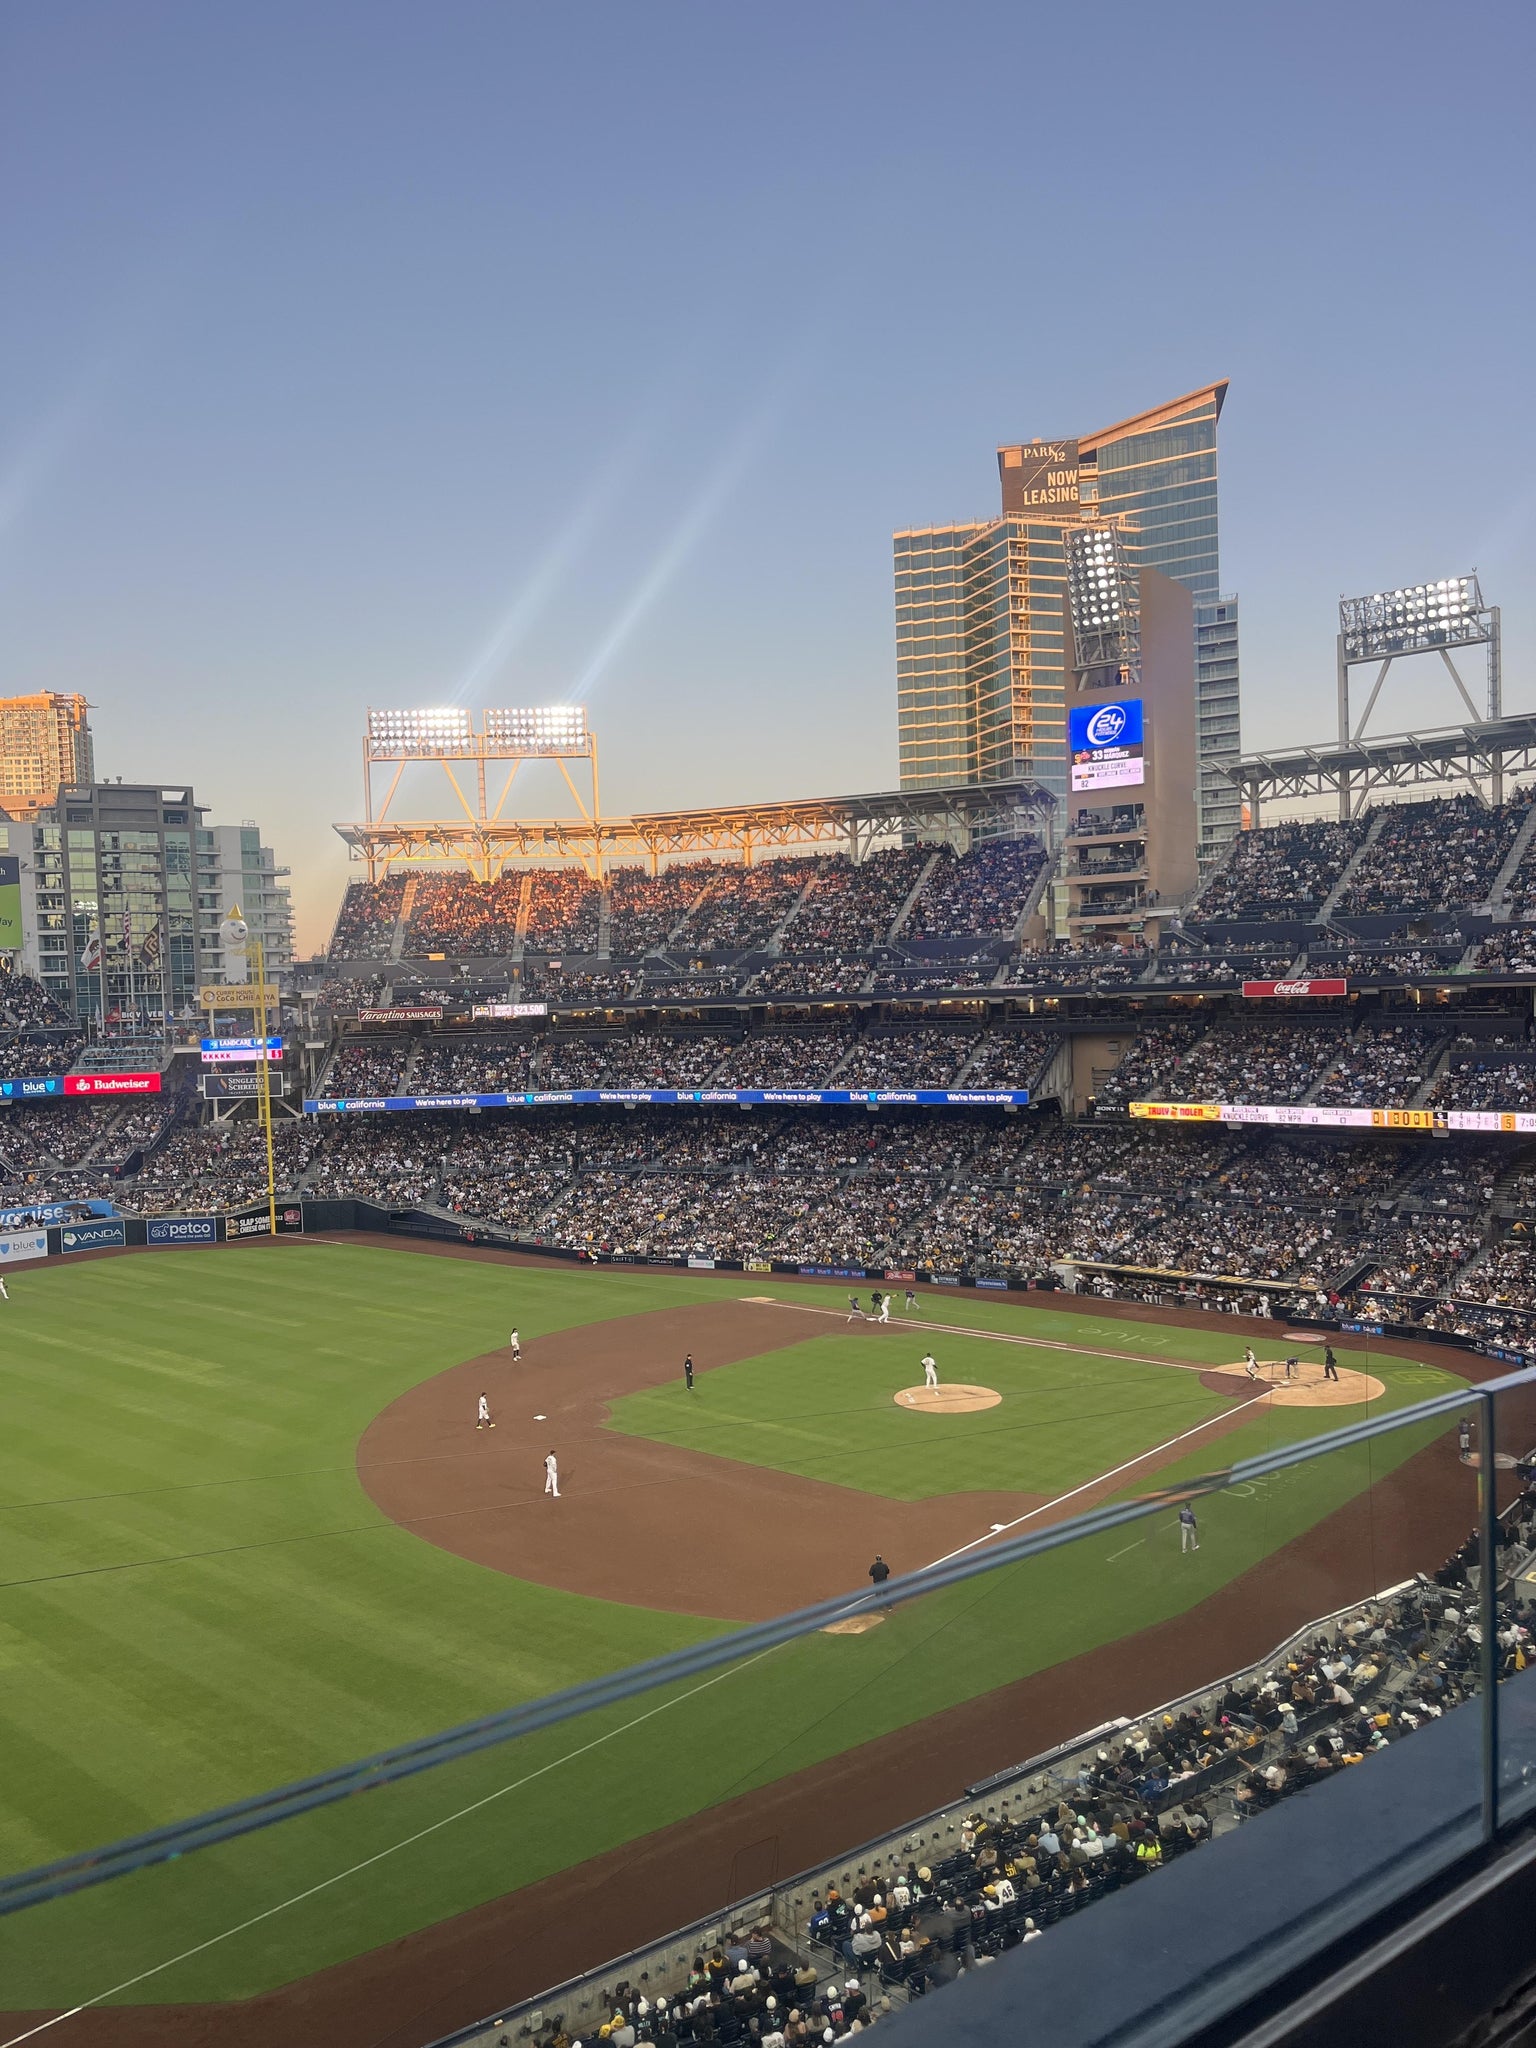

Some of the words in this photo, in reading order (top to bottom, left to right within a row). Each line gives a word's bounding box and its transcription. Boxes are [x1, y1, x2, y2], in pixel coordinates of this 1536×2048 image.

[1024, 447, 1056, 459] PARK
[1048, 470, 1078, 487] NOW
[1024, 486, 1078, 505] LEASING
[1097, 714, 1123, 731] 24
[1092, 750, 1103, 760] 33
[360, 1010, 405, 1020] Tarantino
[23, 1082, 45, 1091] blue
[94, 1079, 150, 1090] Budweiser
[534, 1093, 572, 1101] california
[639, 1093, 652, 1101] play
[807, 1093, 822, 1101] play
[850, 1092, 868, 1100] blue
[877, 1092, 916, 1100] california
[996, 1094, 1013, 1102] play
[318, 1102, 337, 1110] blue
[346, 1100, 385, 1108] california
[462, 1098, 477, 1106] play
[1148, 1107, 1169, 1115] TRULY
[1180, 1108, 1203, 1116] NOLEN
[1506, 1118, 1511, 1128] 5
[239, 1217, 254, 1227] SLAP
[170, 1222, 210, 1237] petco
[239, 1225, 257, 1233] CHEESE
[77, 1229, 123, 1240] VANDA
[13, 1240, 35, 1250] blue
[1002, 1885, 1013, 1898] 46
